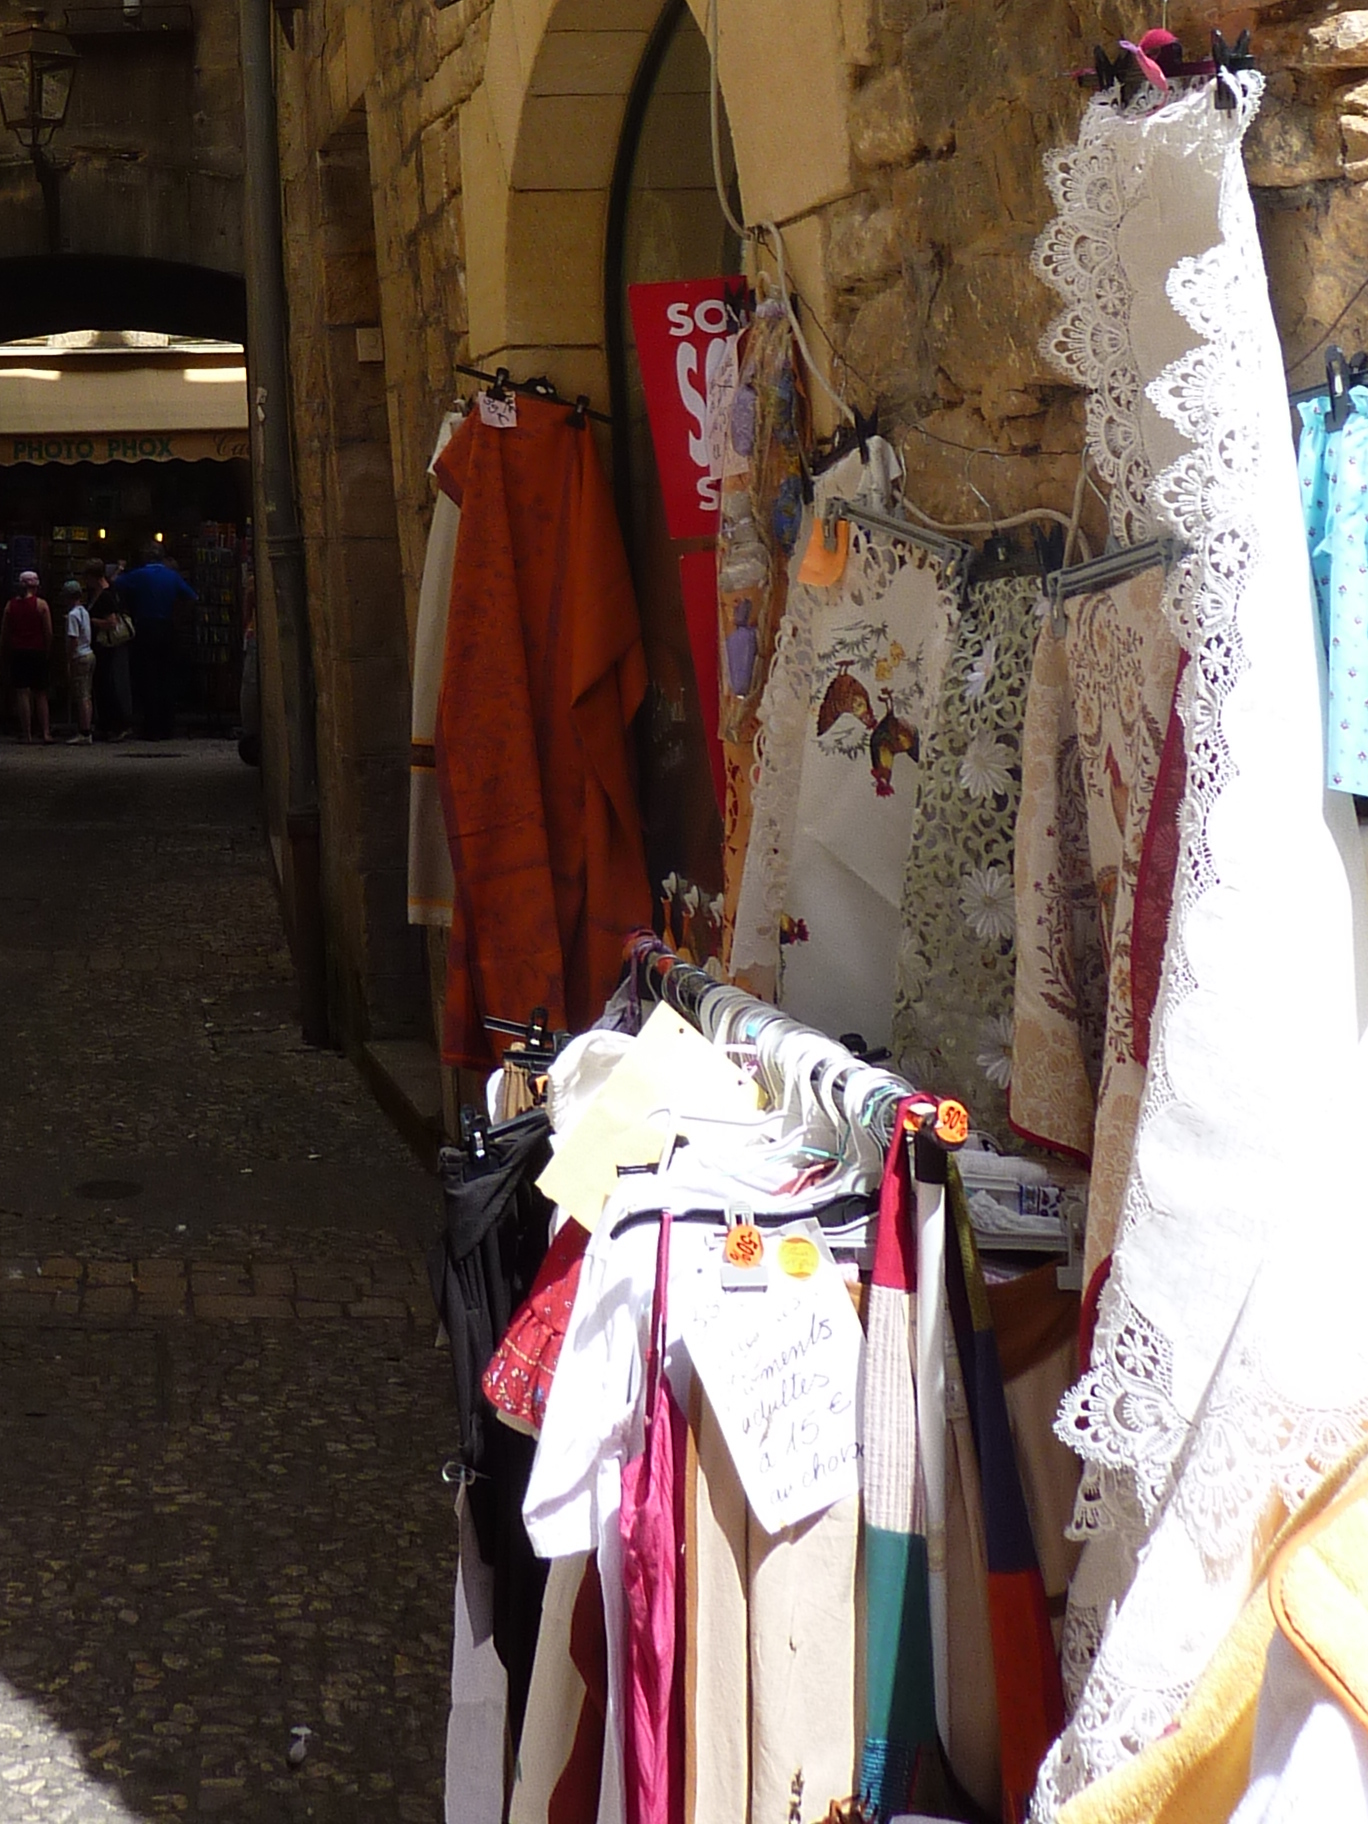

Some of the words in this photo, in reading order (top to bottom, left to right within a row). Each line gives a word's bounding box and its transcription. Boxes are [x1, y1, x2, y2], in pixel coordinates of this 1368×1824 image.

[13, 437, 94, 460] PHOTO
[107, 436, 175, 459] PHOX
[214, 434, 251, 457] Ca
[741, 1371, 831, 1435] adultes
[785, 1409, 820, 1454] 15
[826, 1390, 853, 1415] €
